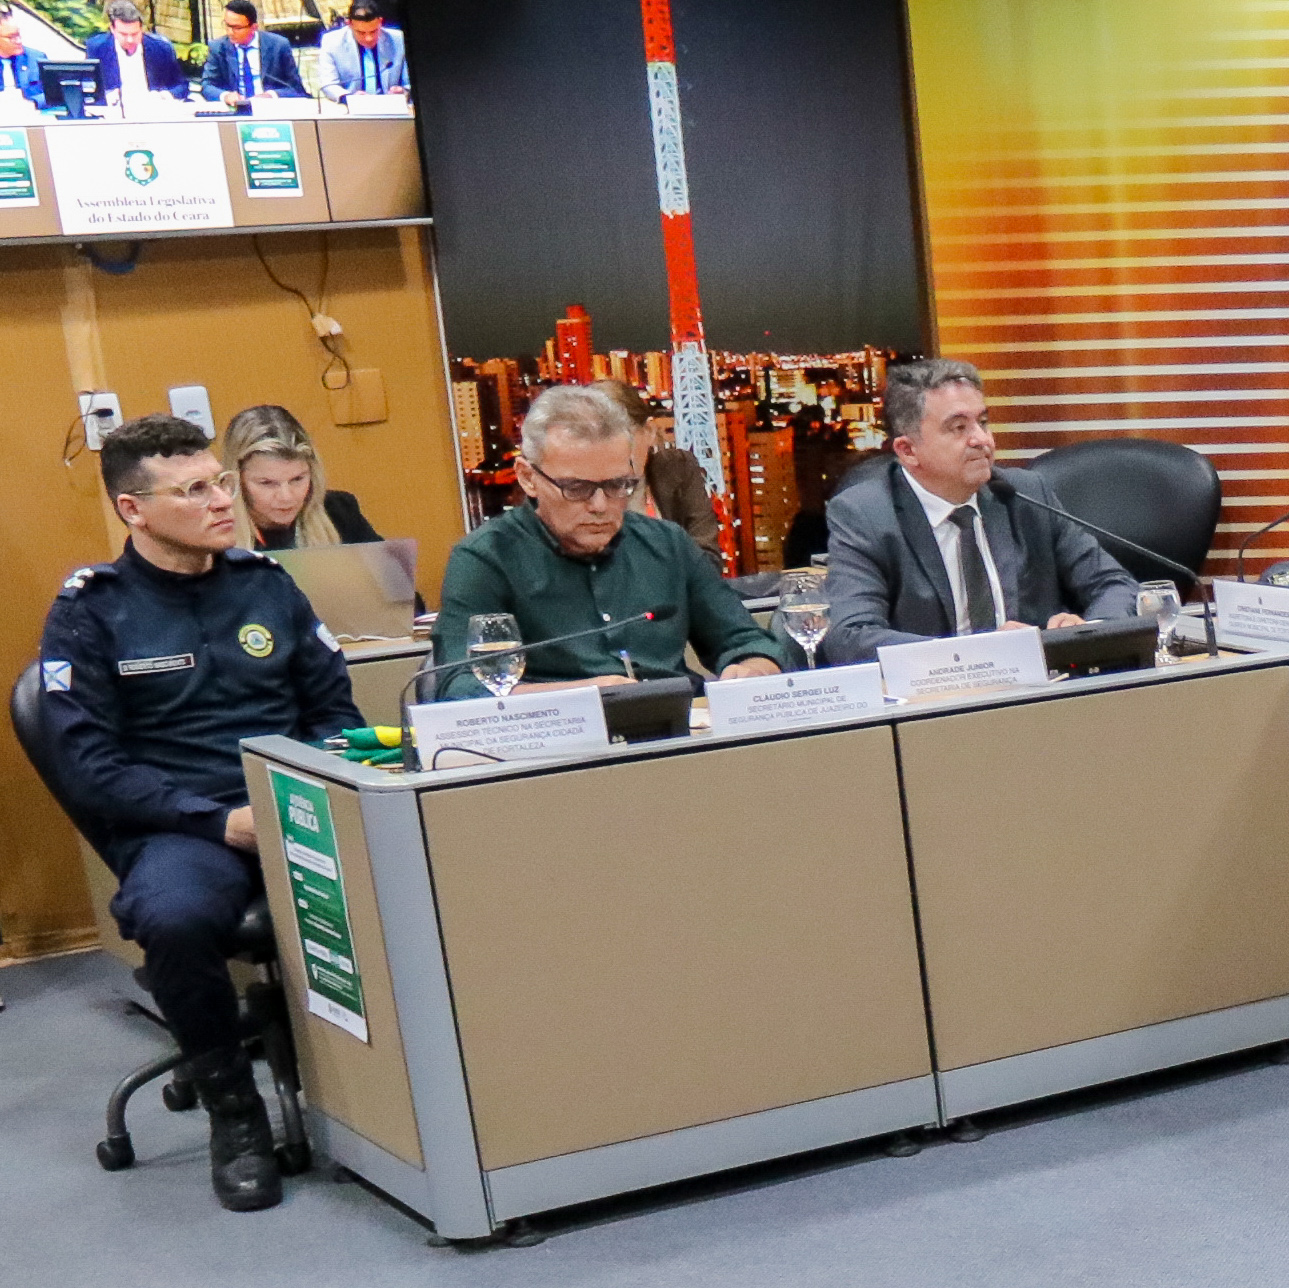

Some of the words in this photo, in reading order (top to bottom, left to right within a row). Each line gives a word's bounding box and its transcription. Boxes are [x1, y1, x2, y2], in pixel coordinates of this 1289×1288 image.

[929, 666, 964, 676] ANDRADE
[792, 688, 822, 698] SERGEI
[824, 686, 839, 694] LUZ
[456, 715, 500, 727] ROBERTO
[501, 709, 559, 722] NASCIMENTO
[435, 729, 479, 740] ASSESSOR
[520, 722, 533, 730] NA
[534, 716, 586, 729] SECRETARIA
[485, 736, 498, 744] DA
[499, 731, 551, 744] SEGURANÇA
[497, 742, 545, 754] FORTALEZA
